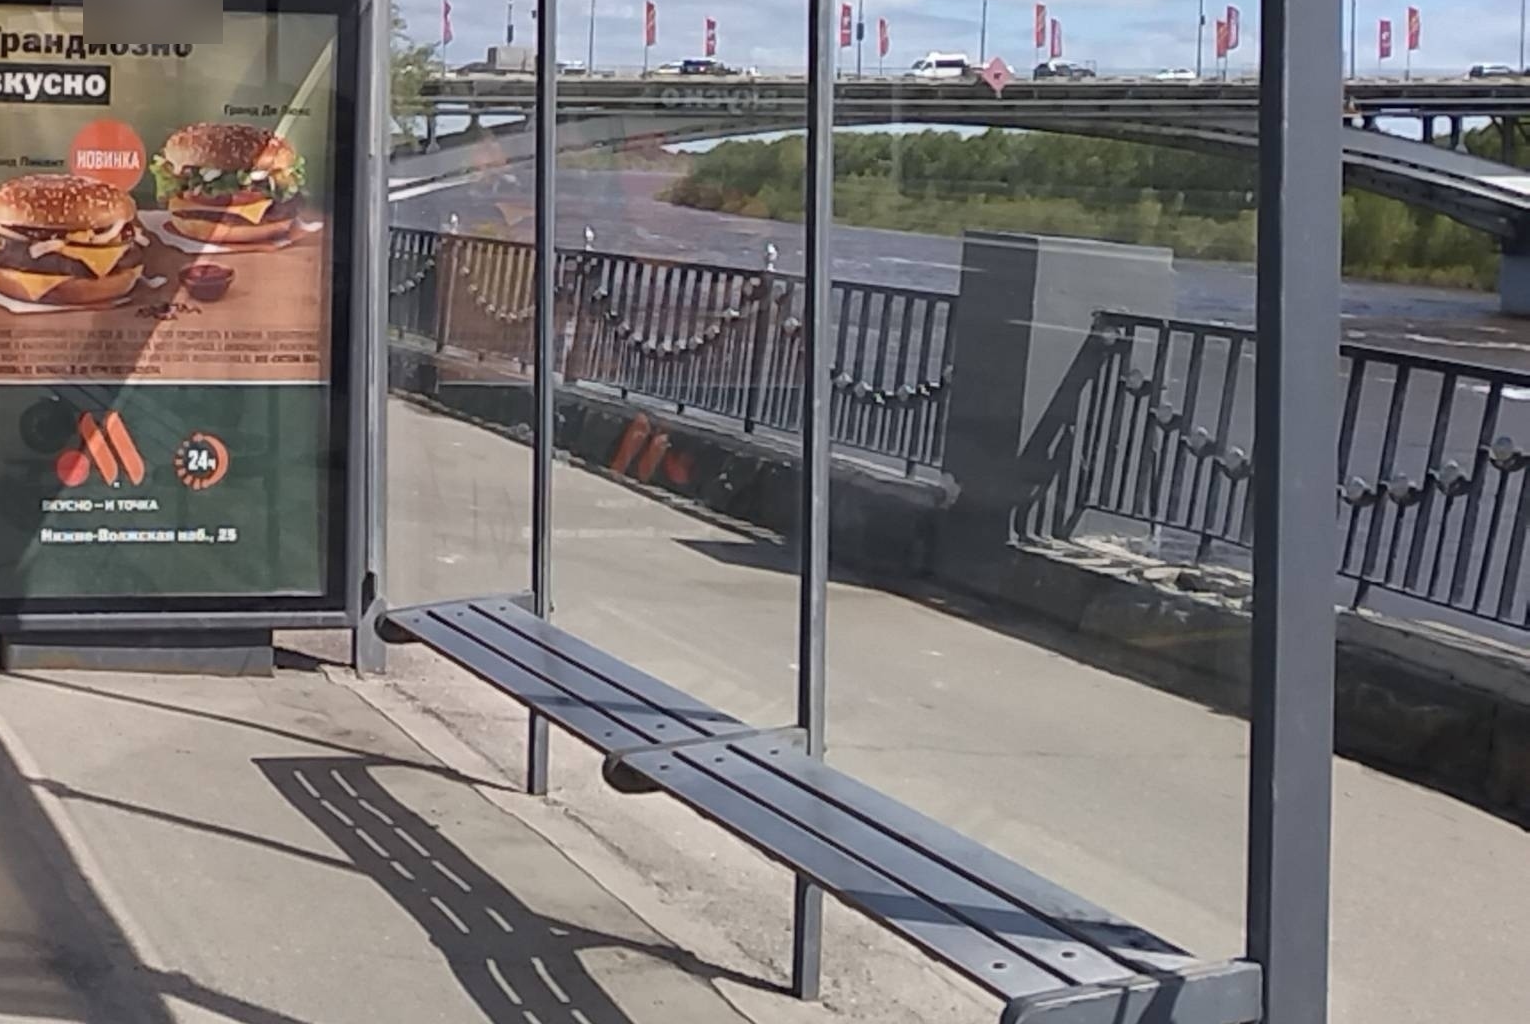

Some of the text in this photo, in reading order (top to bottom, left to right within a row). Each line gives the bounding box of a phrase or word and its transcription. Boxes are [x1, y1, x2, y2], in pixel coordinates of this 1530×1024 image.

[76, 150, 141, 170] НОВИНКА
[41, 500, 93, 512] ВКУСНО
[104, 500, 115, 512] И
[117, 500, 159, 512] ТОЧКА
[40, 528, 176, 543] Нижне-Волжская
